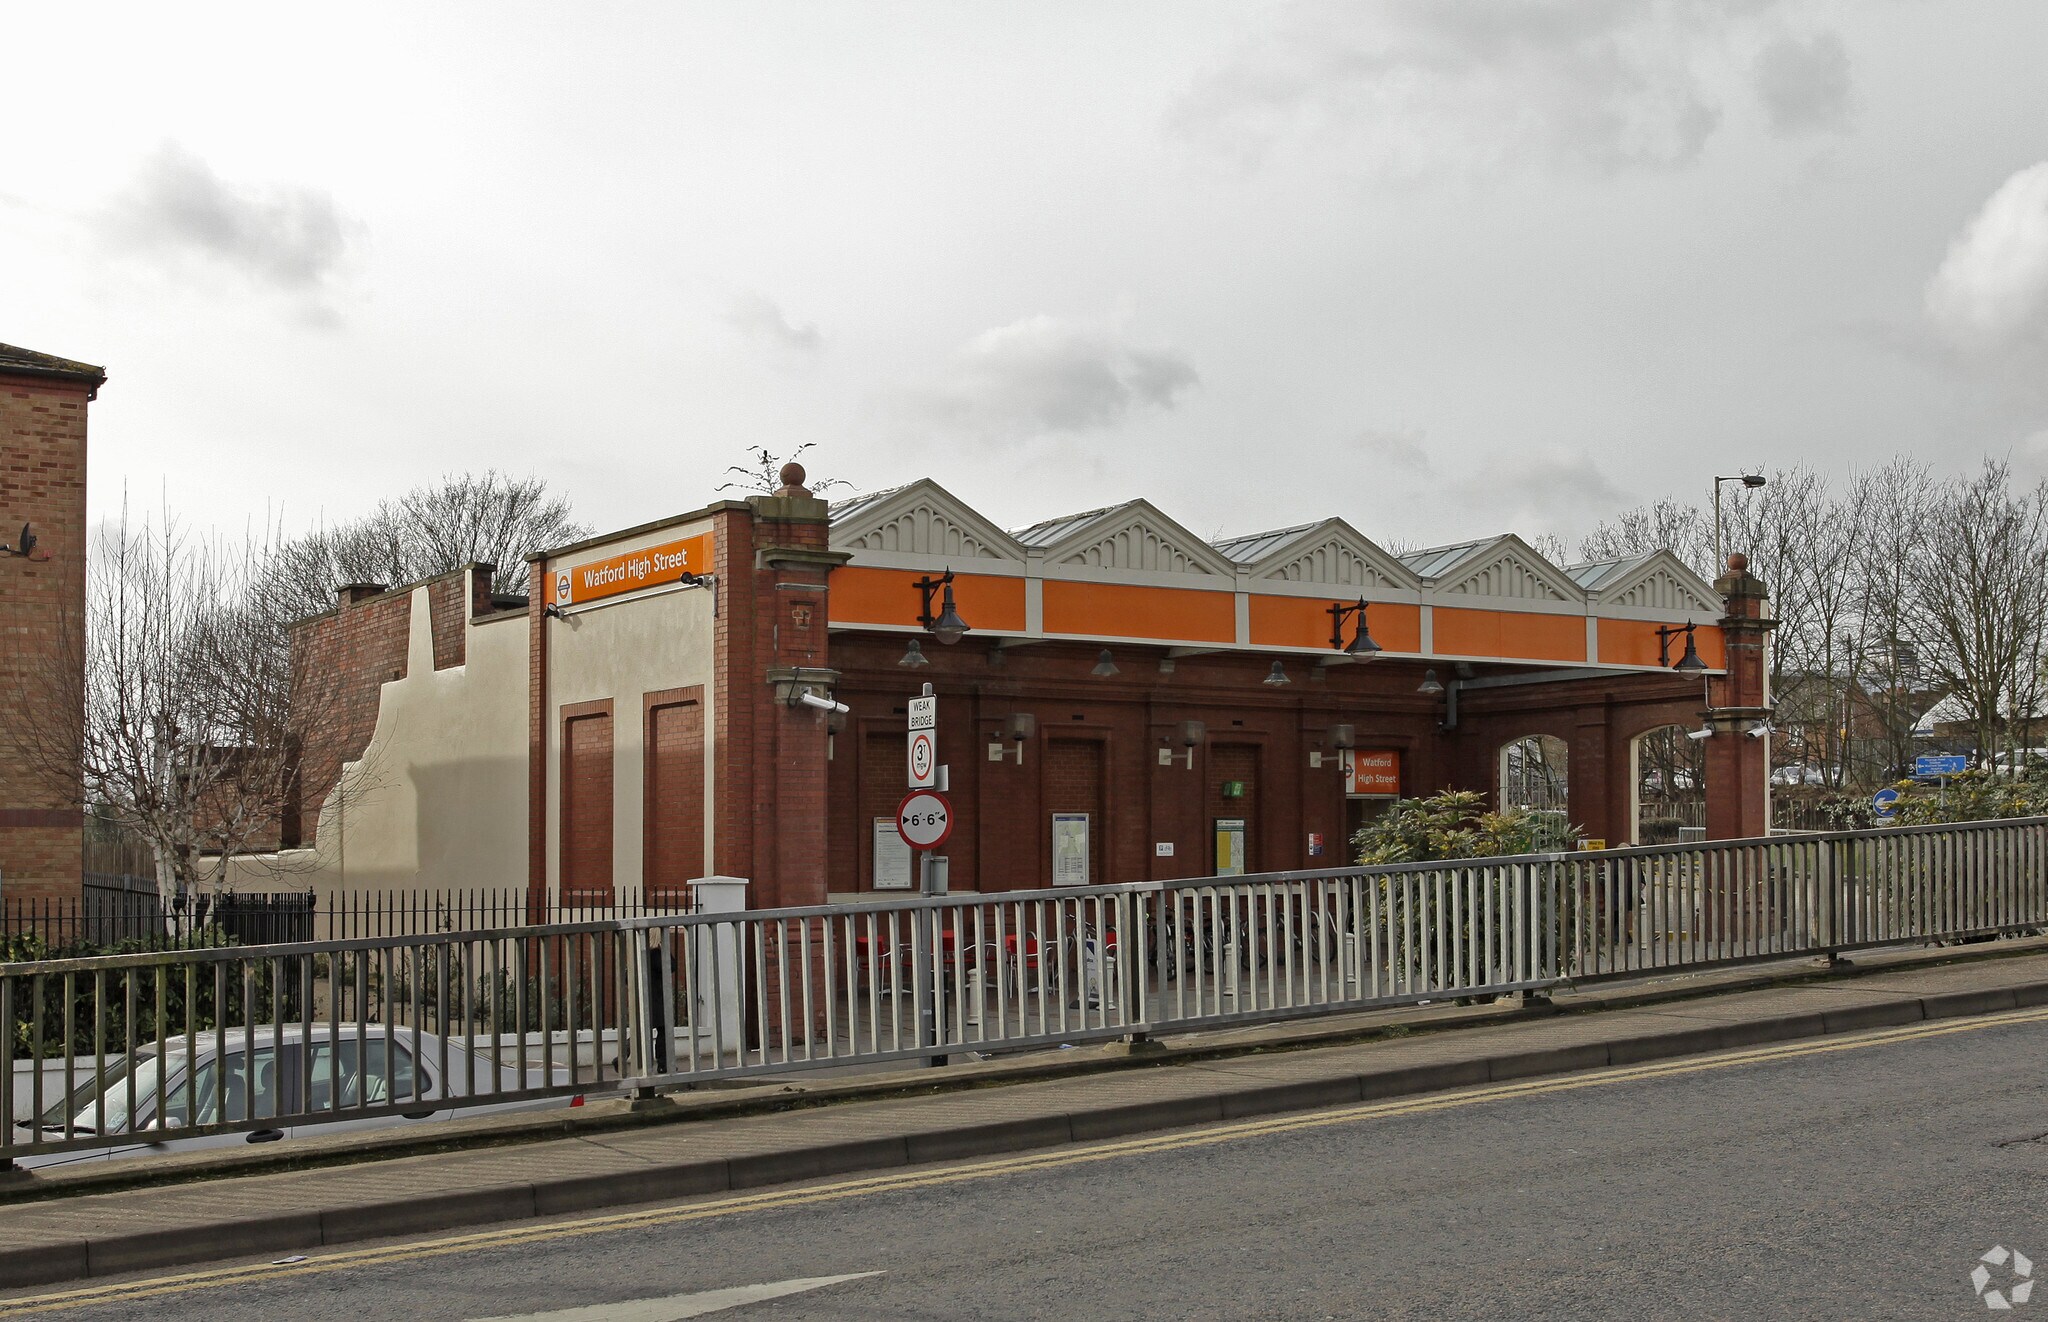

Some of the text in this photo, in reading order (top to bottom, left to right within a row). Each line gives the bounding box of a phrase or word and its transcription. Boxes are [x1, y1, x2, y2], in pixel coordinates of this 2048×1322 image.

[583, 548, 688, 589] Watford High Street
[913, 700, 931, 712] WEAK
[911, 715, 932, 727] BRIDGE
[1362, 758, 1392, 767] Watford
[1358, 774, 1396, 784] High Street
